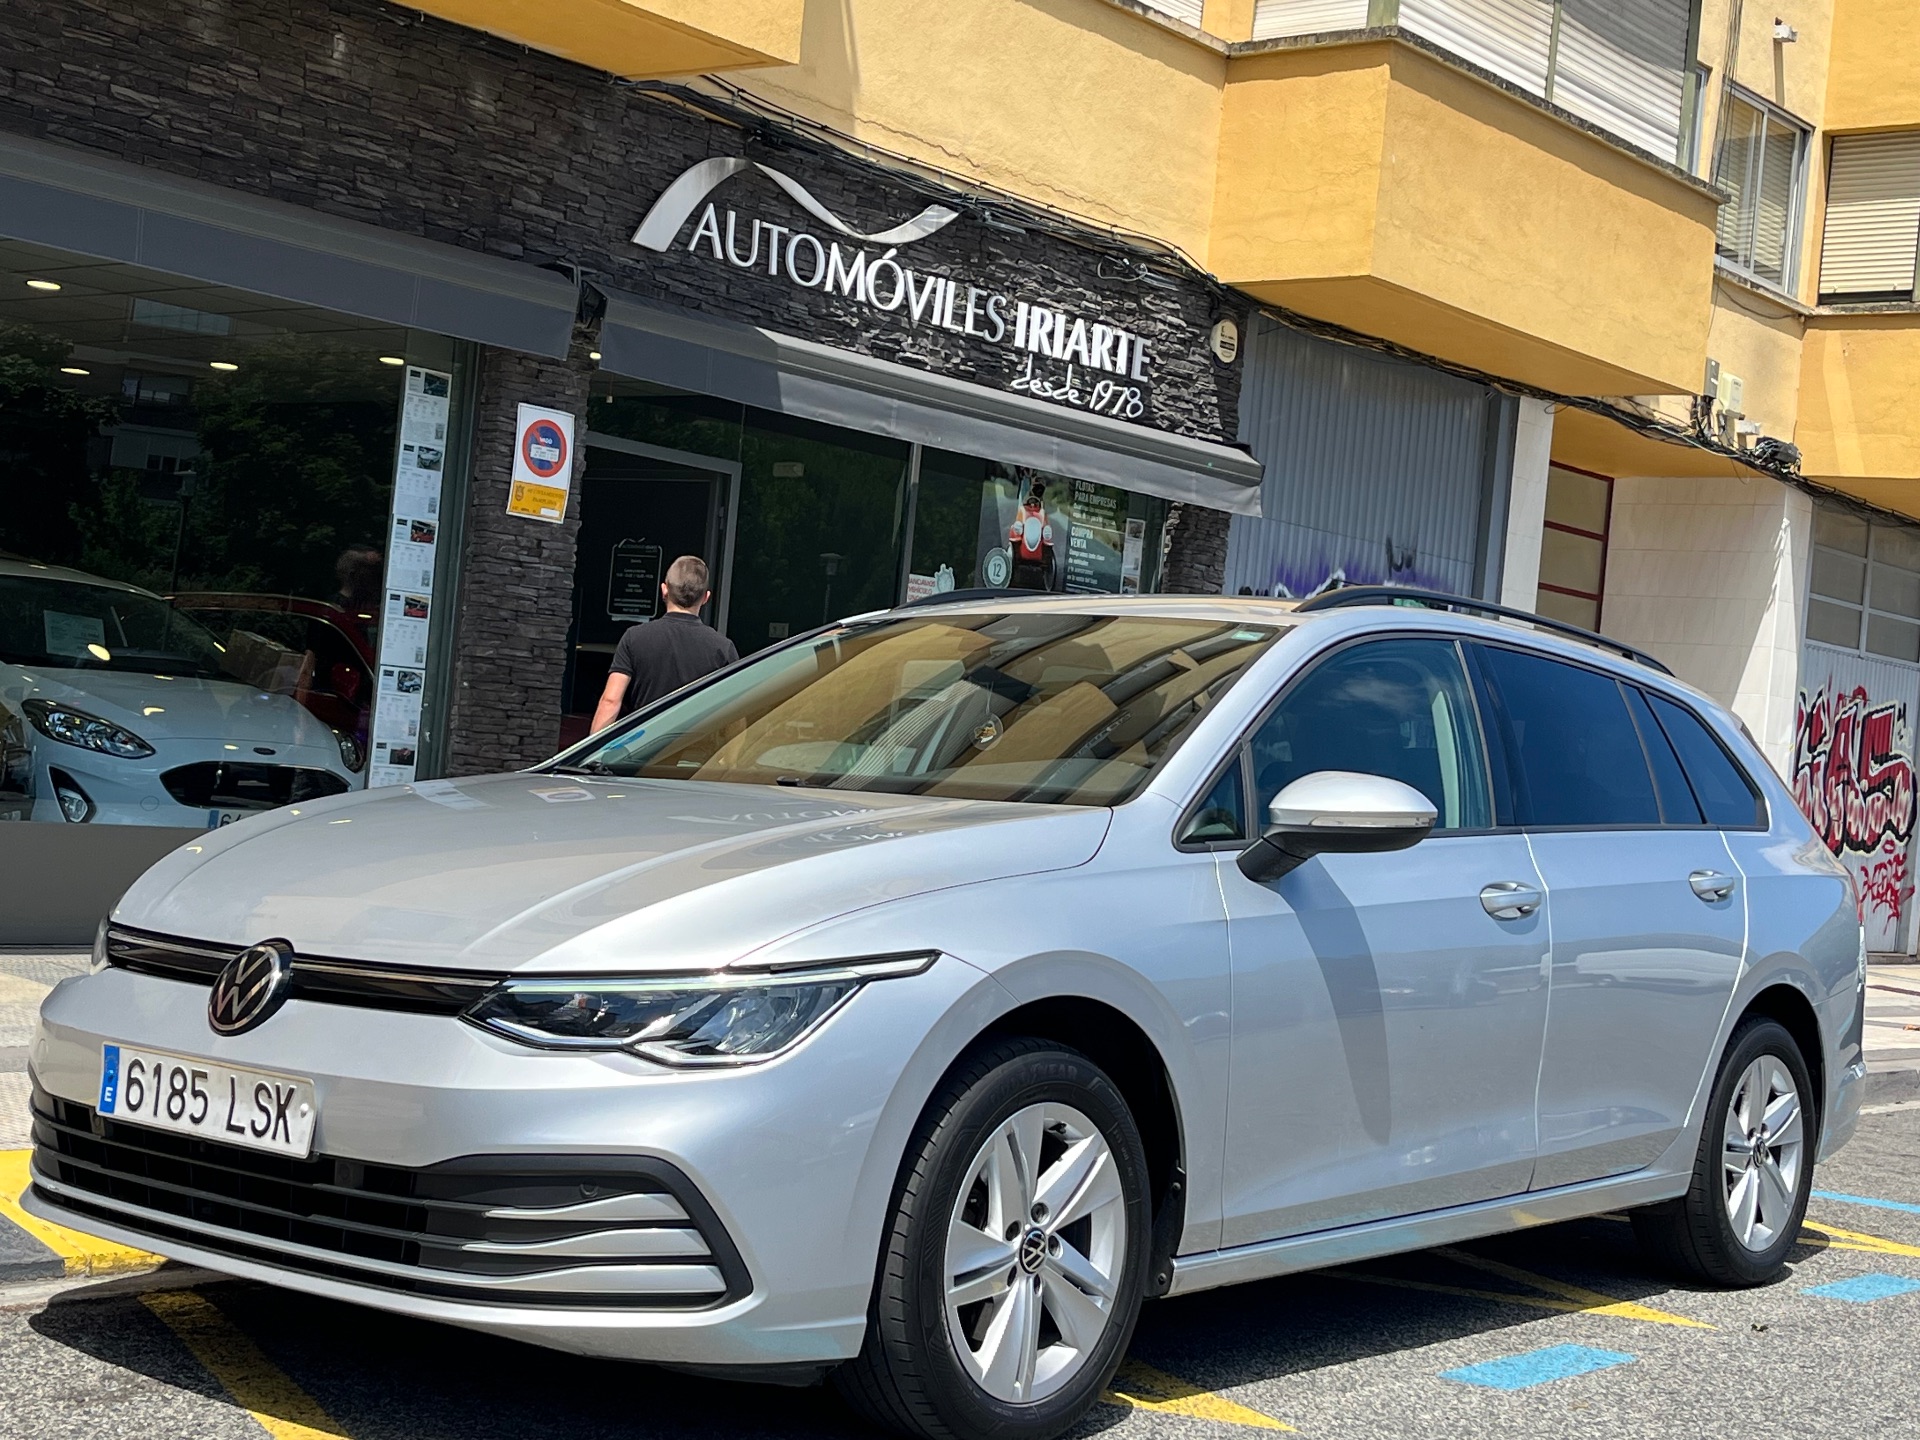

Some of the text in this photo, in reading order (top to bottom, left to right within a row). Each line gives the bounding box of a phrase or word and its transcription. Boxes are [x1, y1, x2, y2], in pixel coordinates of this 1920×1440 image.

[688, 203, 1152, 382] AUTOMÓVILES IRIARTE
[1010, 354, 1144, 419] desde 1978
[1070, 536, 1087, 549] VENTA
[1071, 526, 1094, 540] COMPRA
[992, 562, 1002, 578] 12
[104, 1058, 296, 1143] E 6185 LSK
